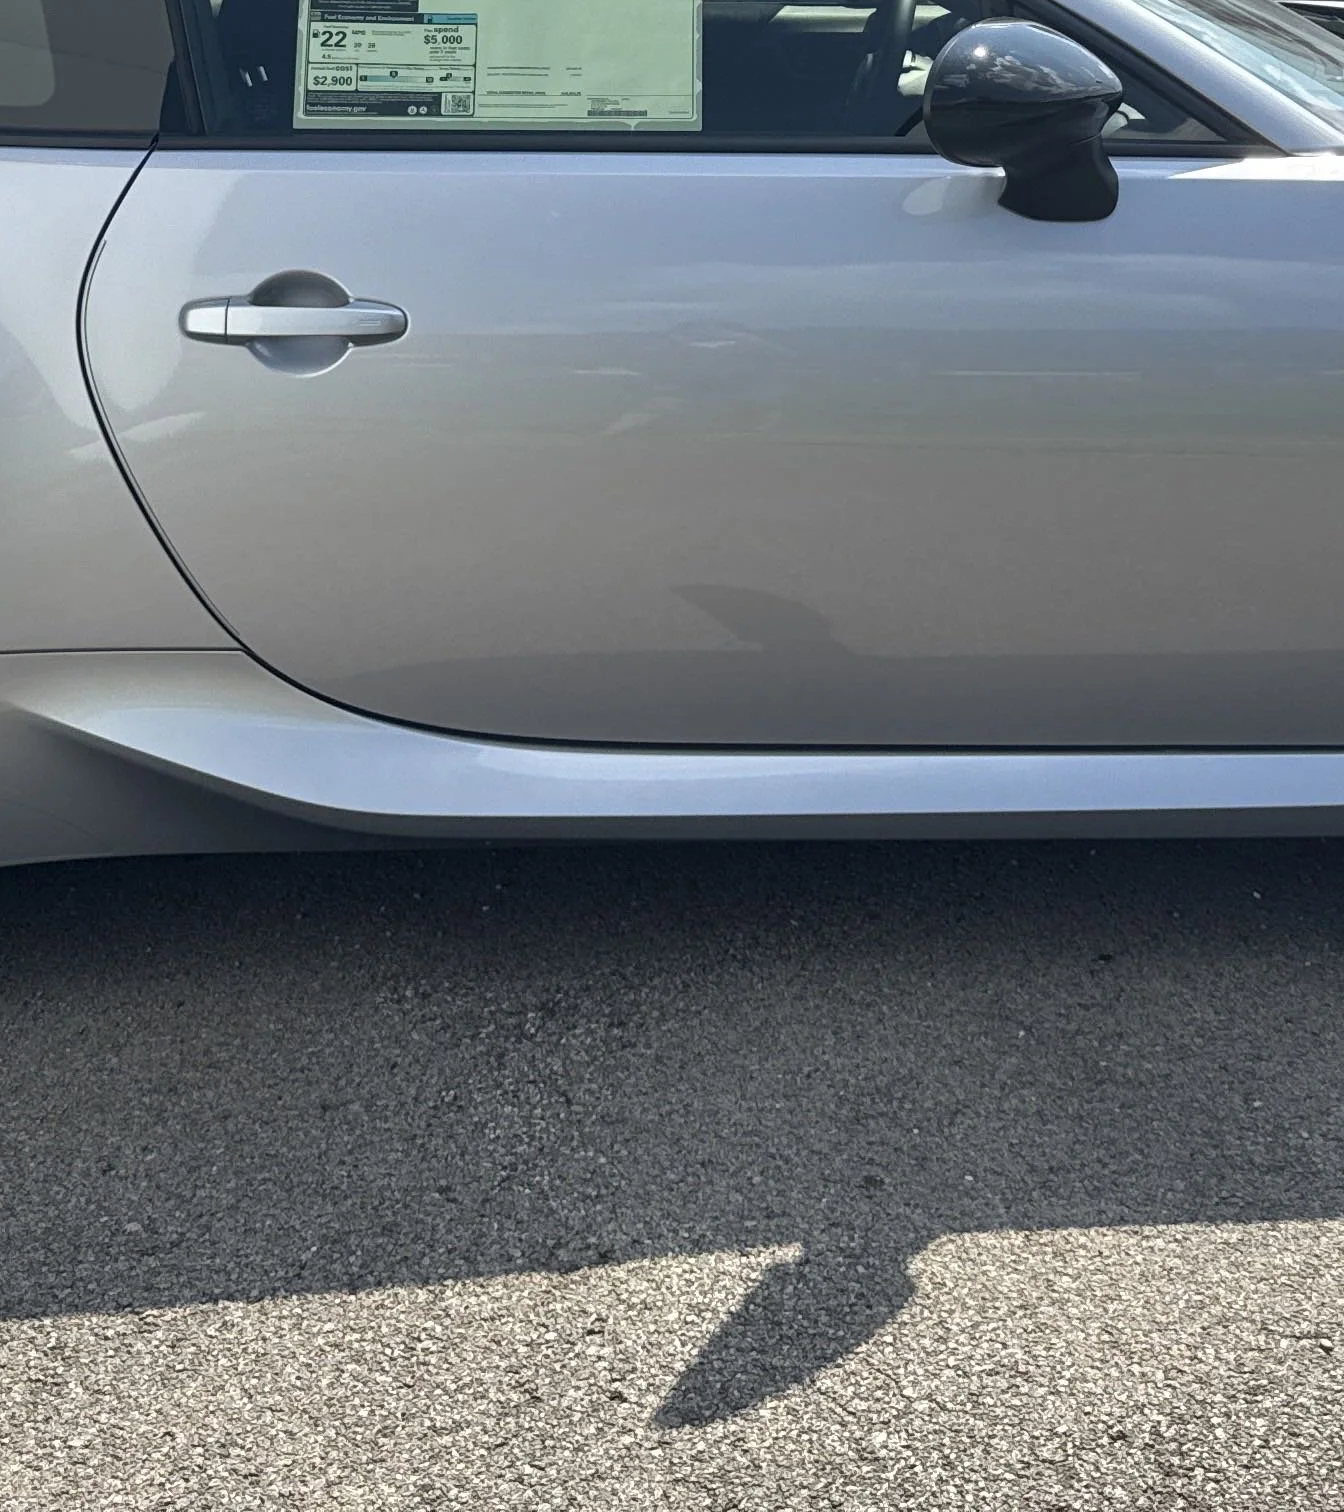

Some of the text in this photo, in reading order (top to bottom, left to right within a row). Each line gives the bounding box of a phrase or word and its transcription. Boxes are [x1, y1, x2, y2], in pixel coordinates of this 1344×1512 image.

[433, 26, 459, 34] spend
[320, 30, 347, 48] 22
[424, 34, 463, 45] $5,000
[312, 75, 353, 87] $2,900
